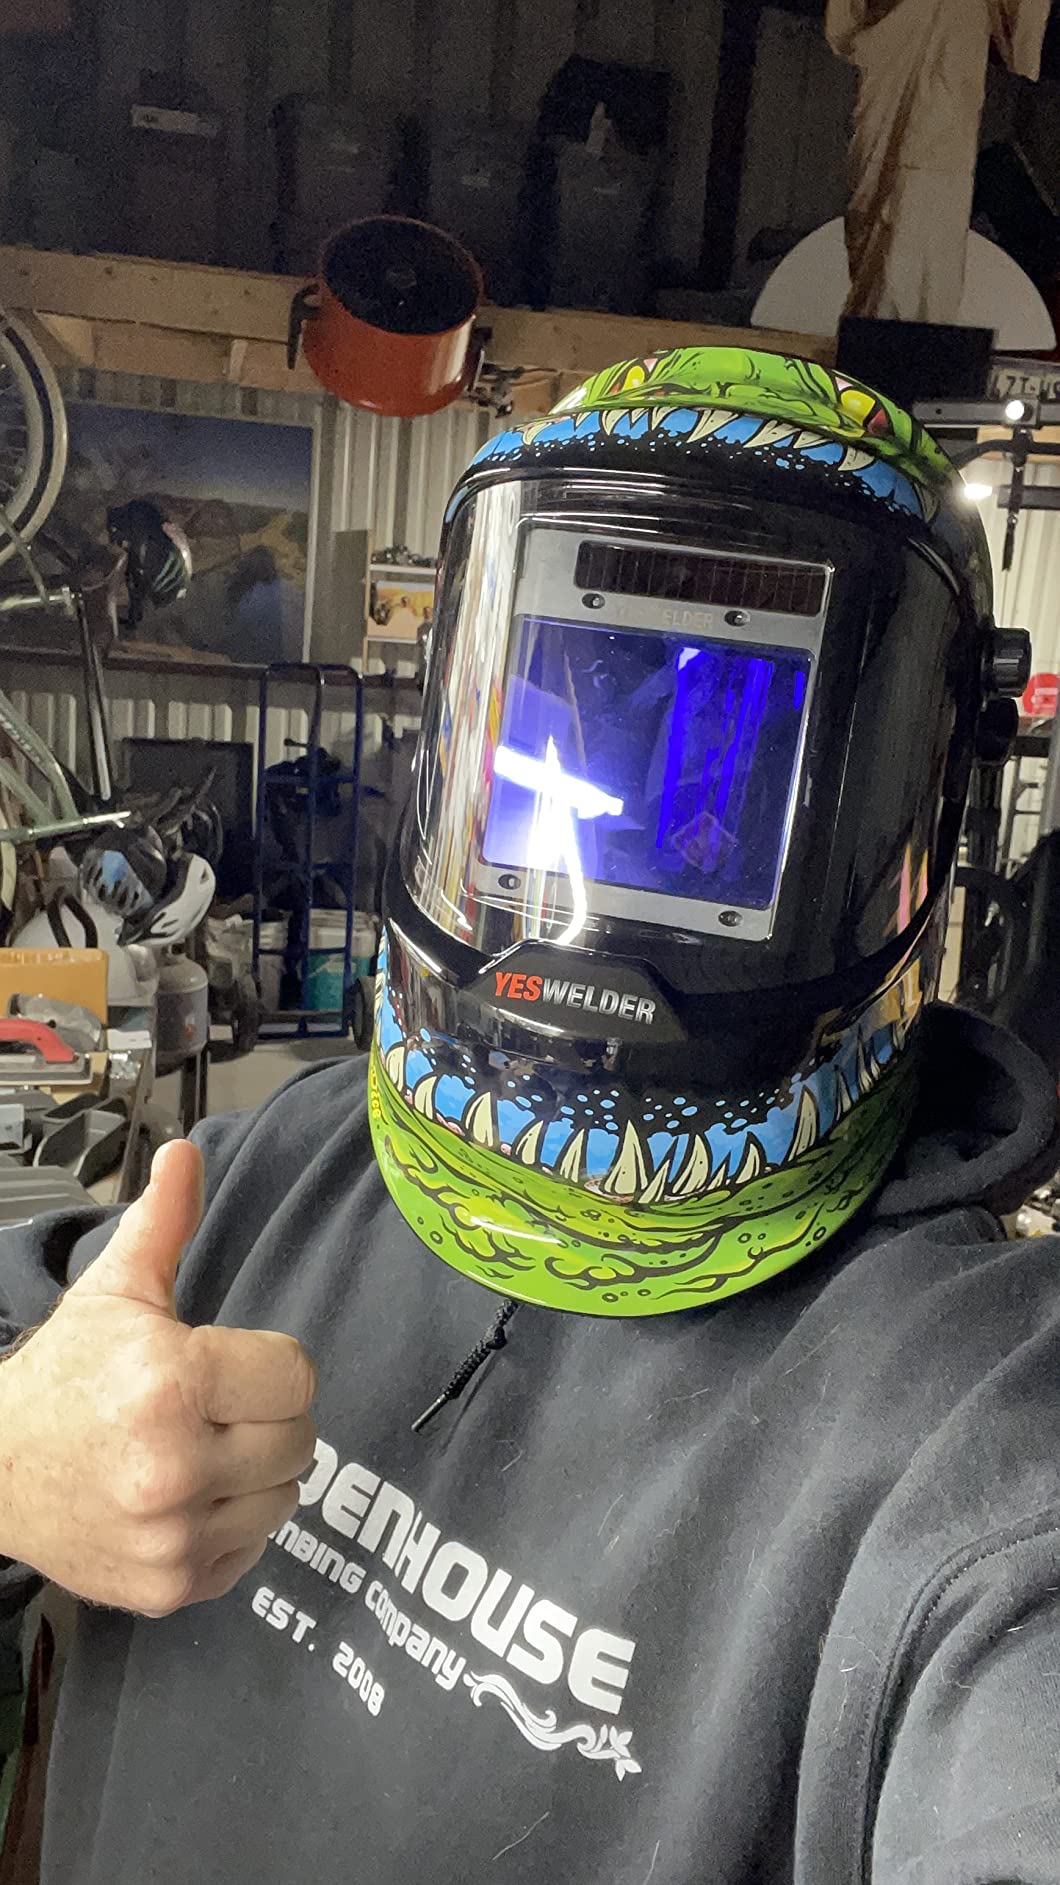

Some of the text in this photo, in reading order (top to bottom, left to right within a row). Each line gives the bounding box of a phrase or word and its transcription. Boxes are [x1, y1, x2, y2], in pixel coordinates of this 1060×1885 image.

[495, 972, 656, 1025] YESWELDER
[251, 1586, 385, 1716] EST. 2008
